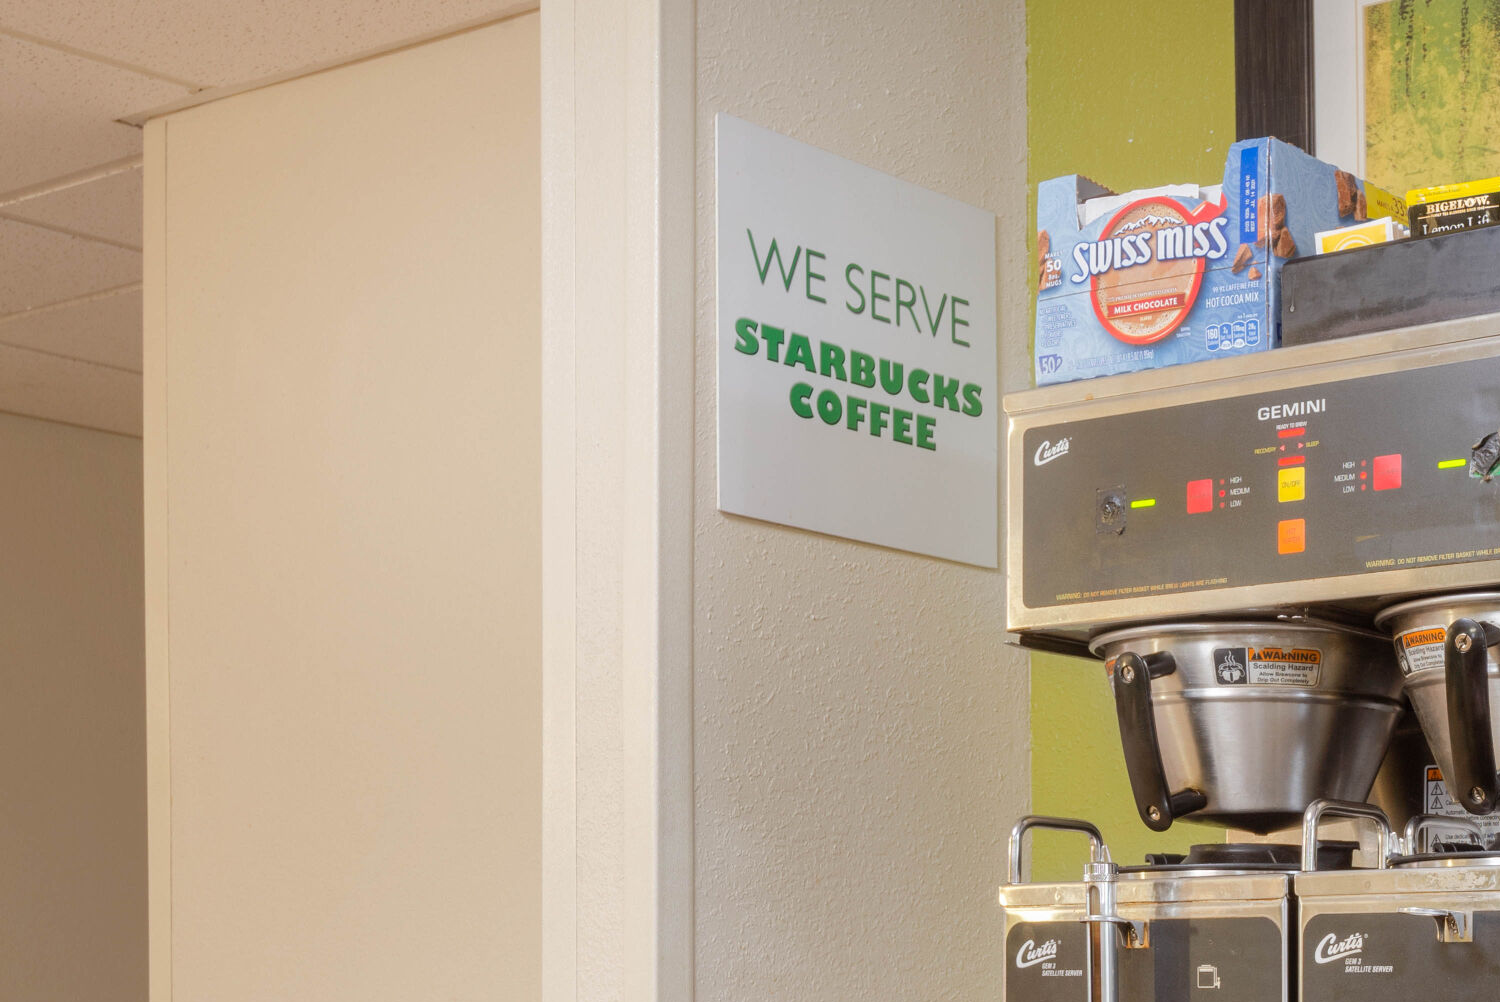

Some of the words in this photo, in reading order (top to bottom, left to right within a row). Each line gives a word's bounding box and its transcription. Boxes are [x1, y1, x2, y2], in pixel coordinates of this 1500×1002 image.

[1071, 232, 1151, 284] SWISS
[1157, 218, 1227, 260] MISS
[1046, 259, 1061, 272] 50
[746, 228, 828, 304] WE
[845, 262, 971, 348] SERVE
[1114, 305, 1131, 314] MILK
[1134, 297, 1178, 311] CHOCOLATE
[1206, 297, 1221, 308] HOT
[1221, 294, 1244, 306] COCOA
[1245, 292, 1259, 302] MIX
[734, 317, 983, 418] STARBUCKS
[789, 381, 937, 451] COFFEE
[1258, 399, 1326, 421] GEMINI
[1034, 438, 1069, 466] Curtis
[1343, 461, 1355, 469] HIGH
[1230, 476, 1242, 484] HIGH
[1334, 473, 1355, 482] MEDIUM
[1230, 487, 1250, 495] MEDIUM
[1343, 485, 1355, 493] LOW
[1230, 500, 1241, 508] LOW
[1417, 554, 1438, 563] REMOVE
[1438, 553, 1455, 561] FILTER
[1455, 550, 1475, 559] BASKET
[1476, 548, 1493, 557] WHILE
[1411, 632, 1444, 644] WARNING
[1264, 651, 1317, 661] WARNING
[1253, 663, 1286, 671] Scalding
[1288, 663, 1313, 671] Hazard
[1016, 939, 1056, 968] Curtis
[1315, 933, 1362, 964] Curtis
